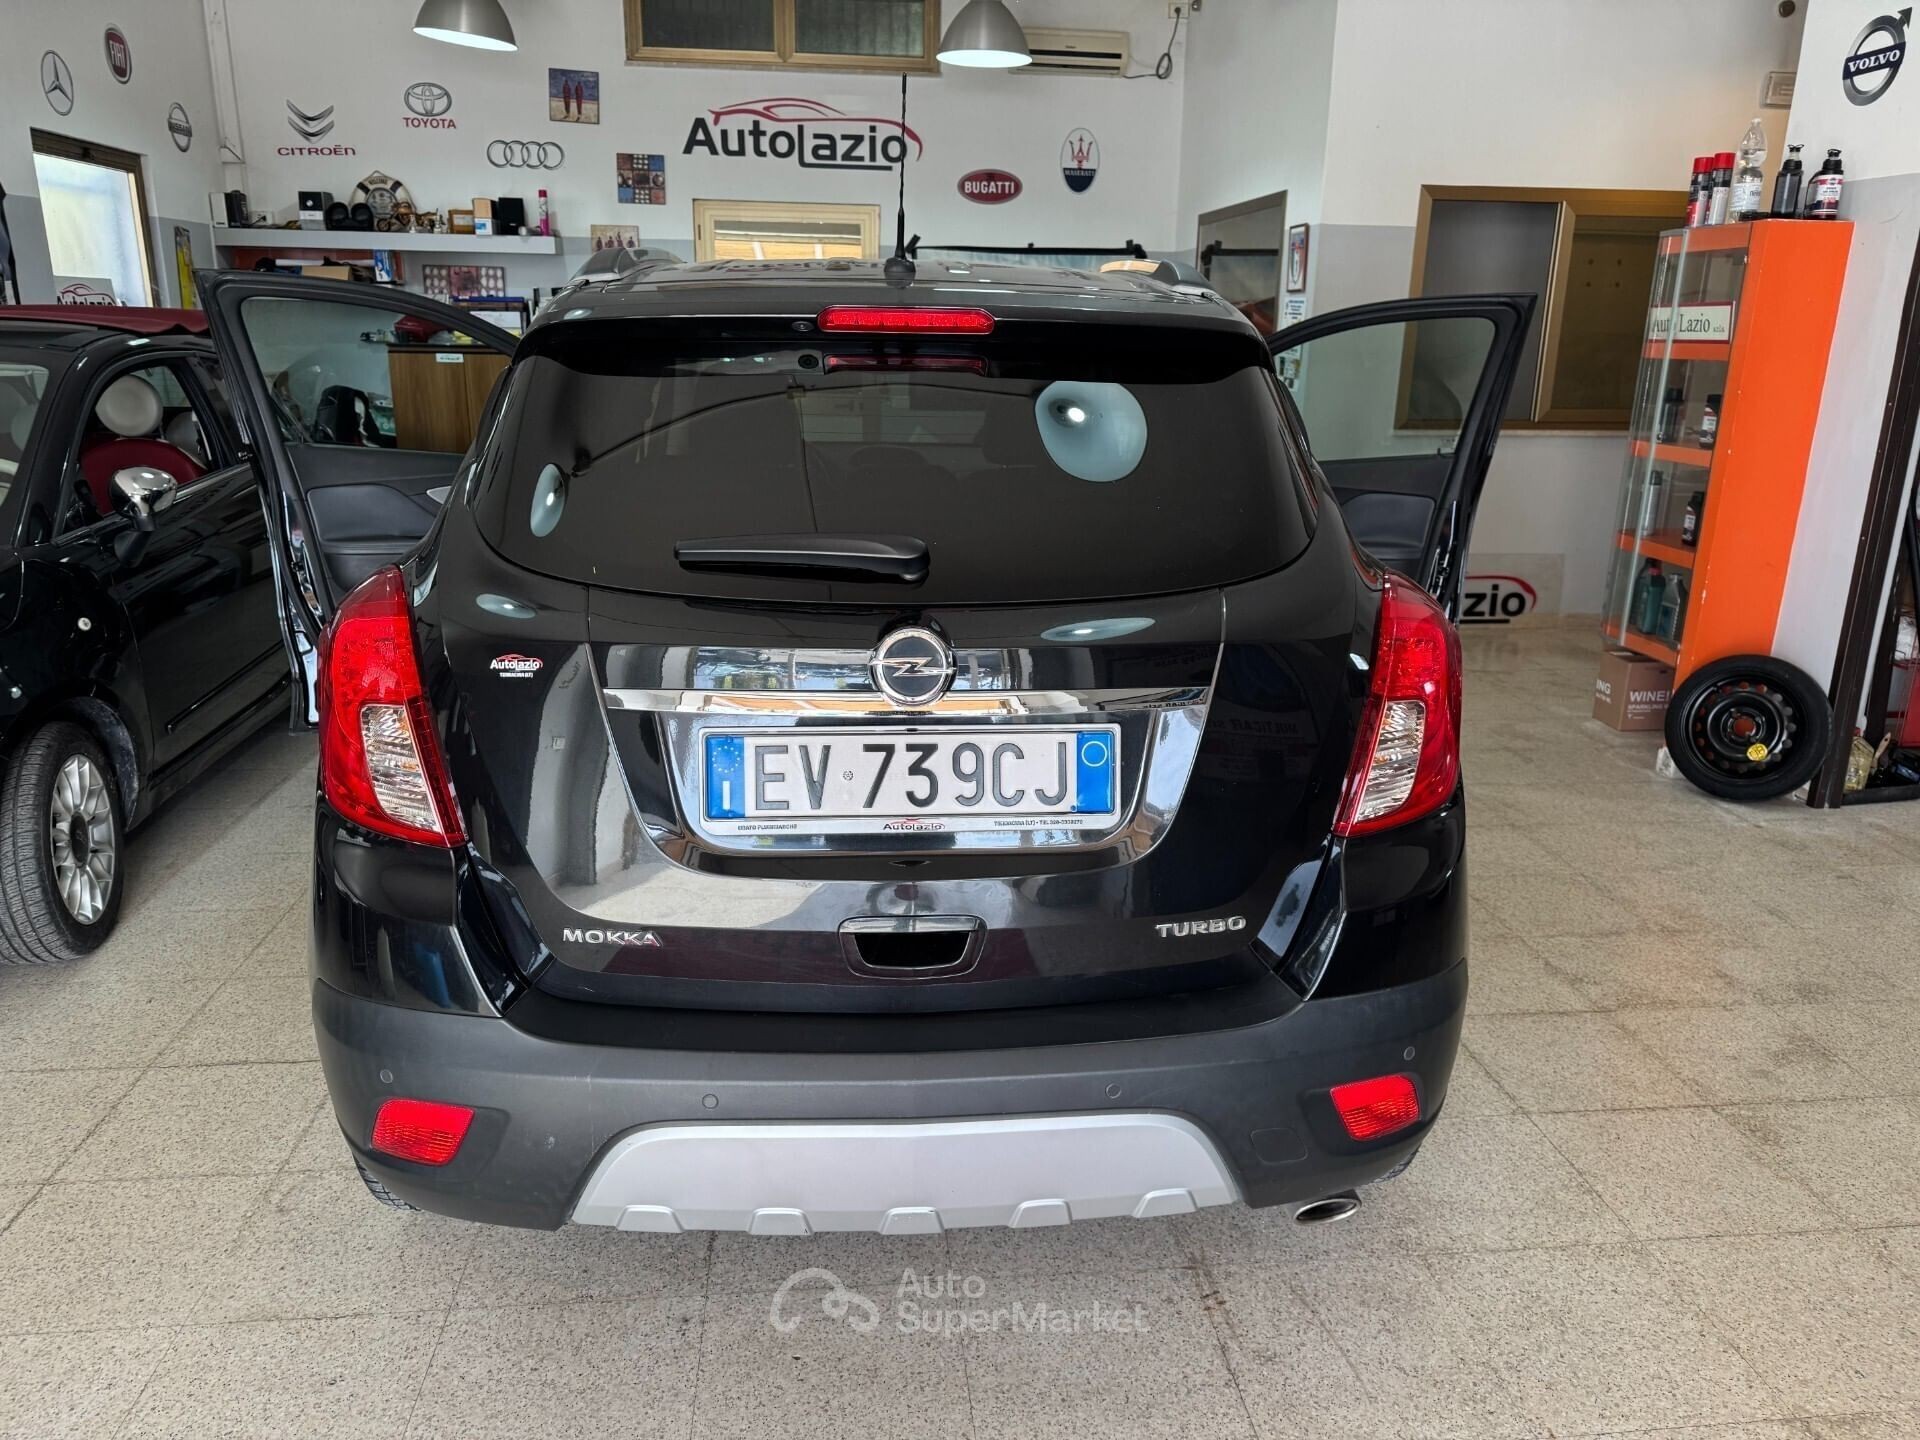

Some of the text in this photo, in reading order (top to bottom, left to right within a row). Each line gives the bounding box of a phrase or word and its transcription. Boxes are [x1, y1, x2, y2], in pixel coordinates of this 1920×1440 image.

[109, 40, 126, 69] FIAT
[1848, 50, 1900, 72] VOLVO
[403, 117, 456, 129] TOYOTA
[1064, 169, 1095, 177] MASERATI
[964, 181, 1015, 194] BUGATTI
[1679, 313, 1711, 333] Lazio
[754, 740, 1069, 811] EV 739CJ
[563, 927, 663, 948] MOKKA
[1155, 916, 1246, 938] TURBO
